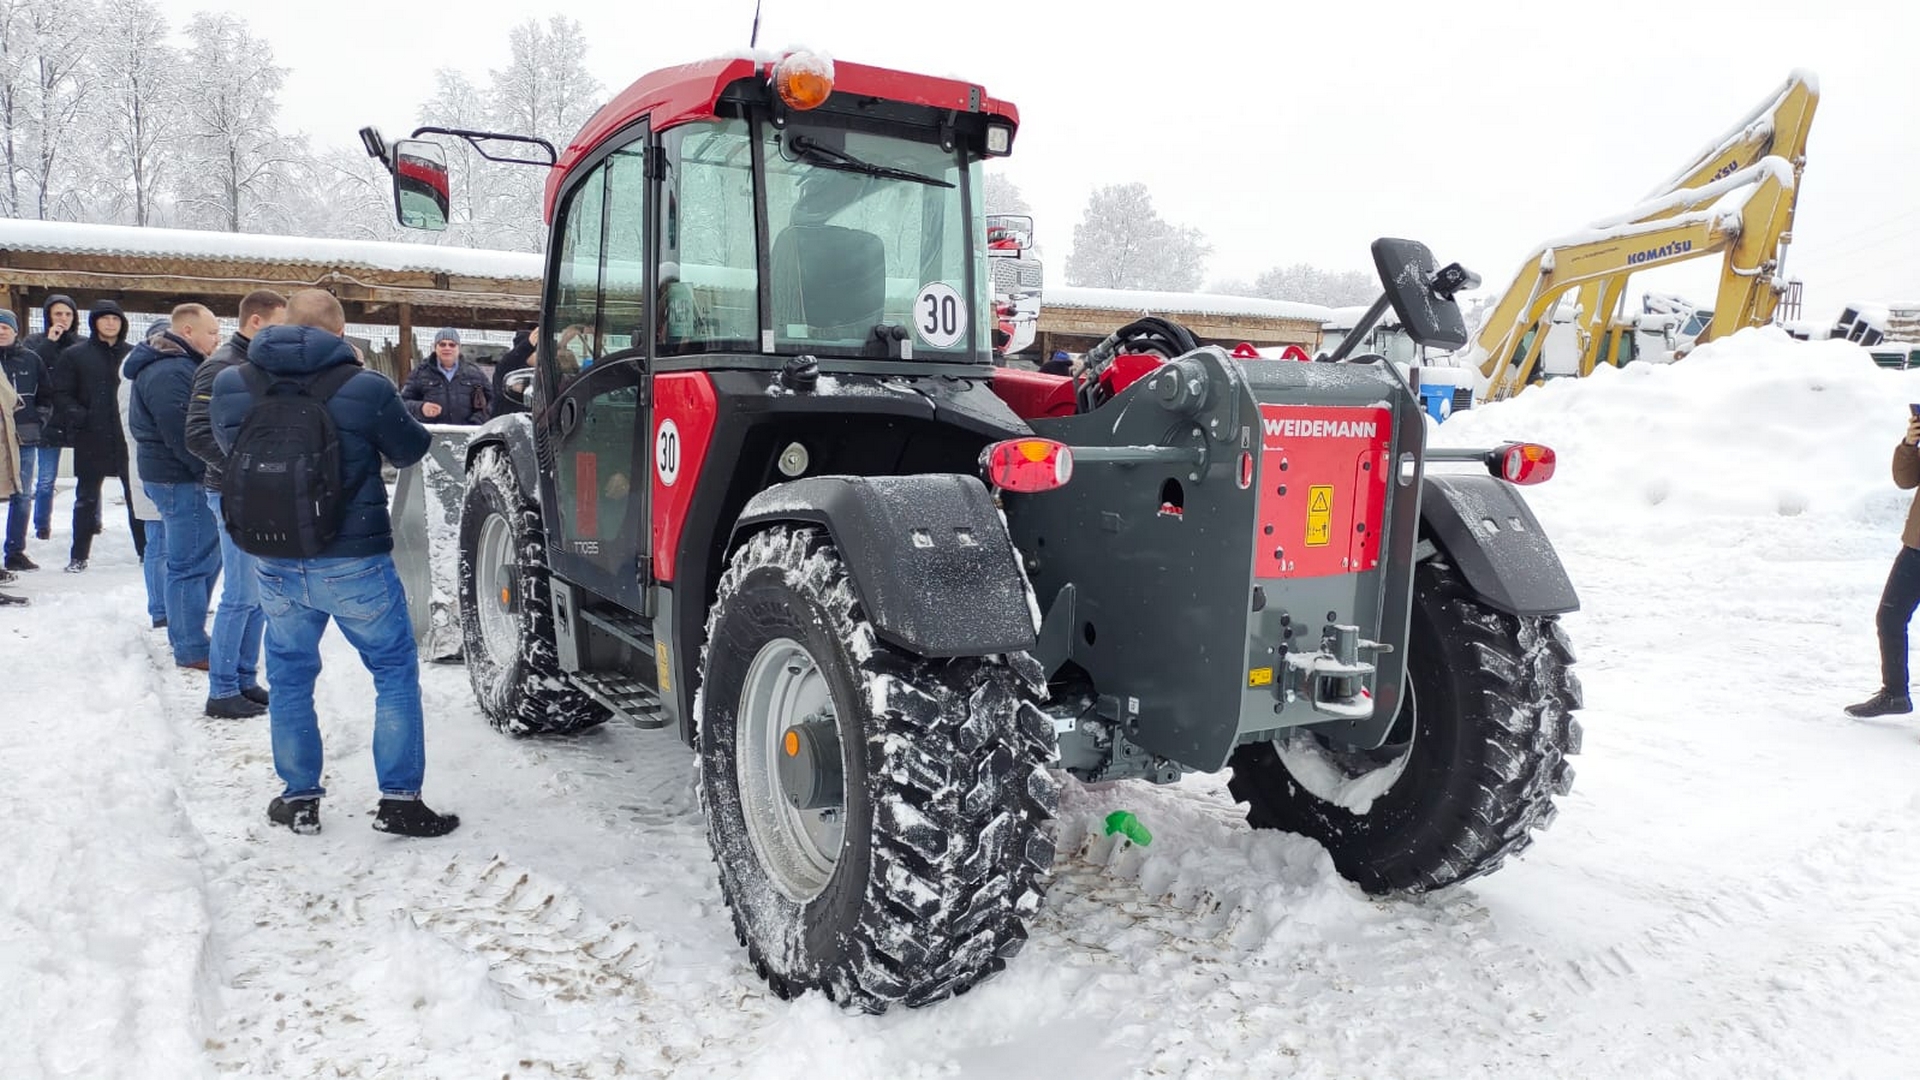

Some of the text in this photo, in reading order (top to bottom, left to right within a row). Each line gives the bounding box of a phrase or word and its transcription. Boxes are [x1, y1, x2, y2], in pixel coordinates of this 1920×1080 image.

[1627, 240, 1692, 265] KOMATSU
[923, 293, 957, 336] 30
[1263, 418, 1377, 438] WEIDEMANN
[660, 431, 675, 473] 30
